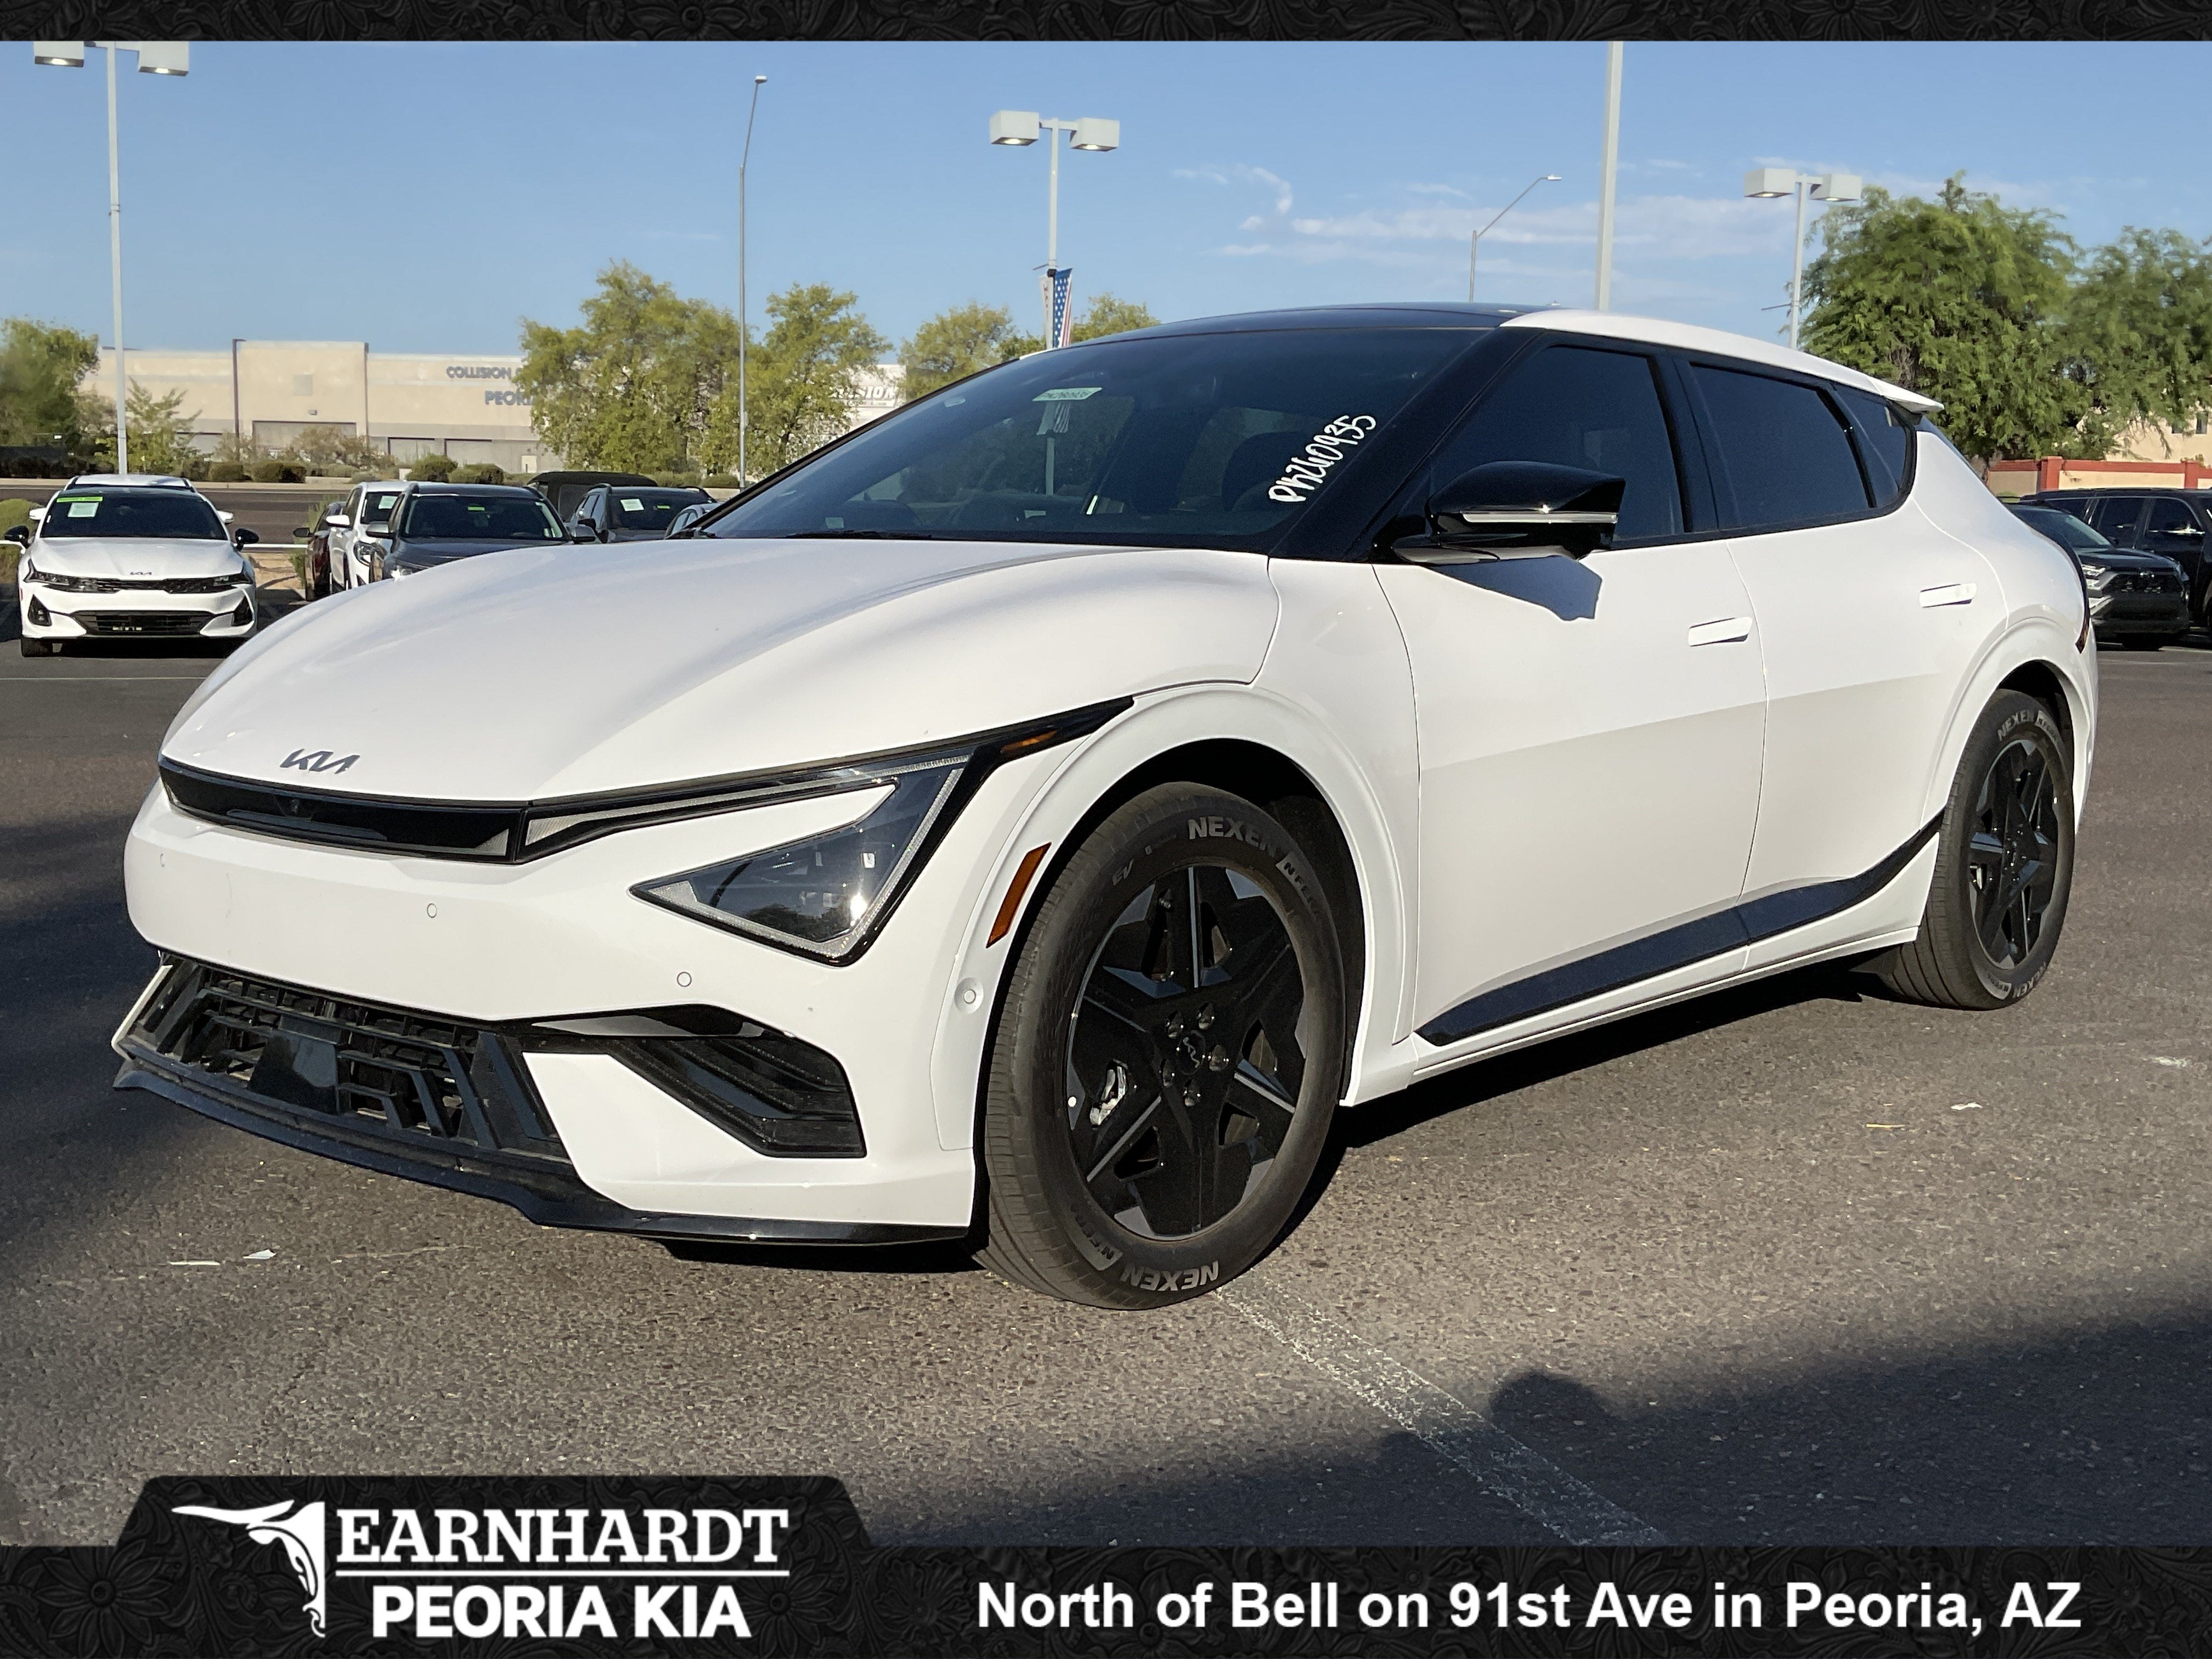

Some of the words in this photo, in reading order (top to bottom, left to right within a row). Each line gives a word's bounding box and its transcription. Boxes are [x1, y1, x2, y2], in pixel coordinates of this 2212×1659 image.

[446, 366, 512, 379] COLLISION
[280, 748, 361, 775] KIA
[1187, 816, 1279, 858] NEXEN
[1120, 1261, 1219, 1291] NEXEN
